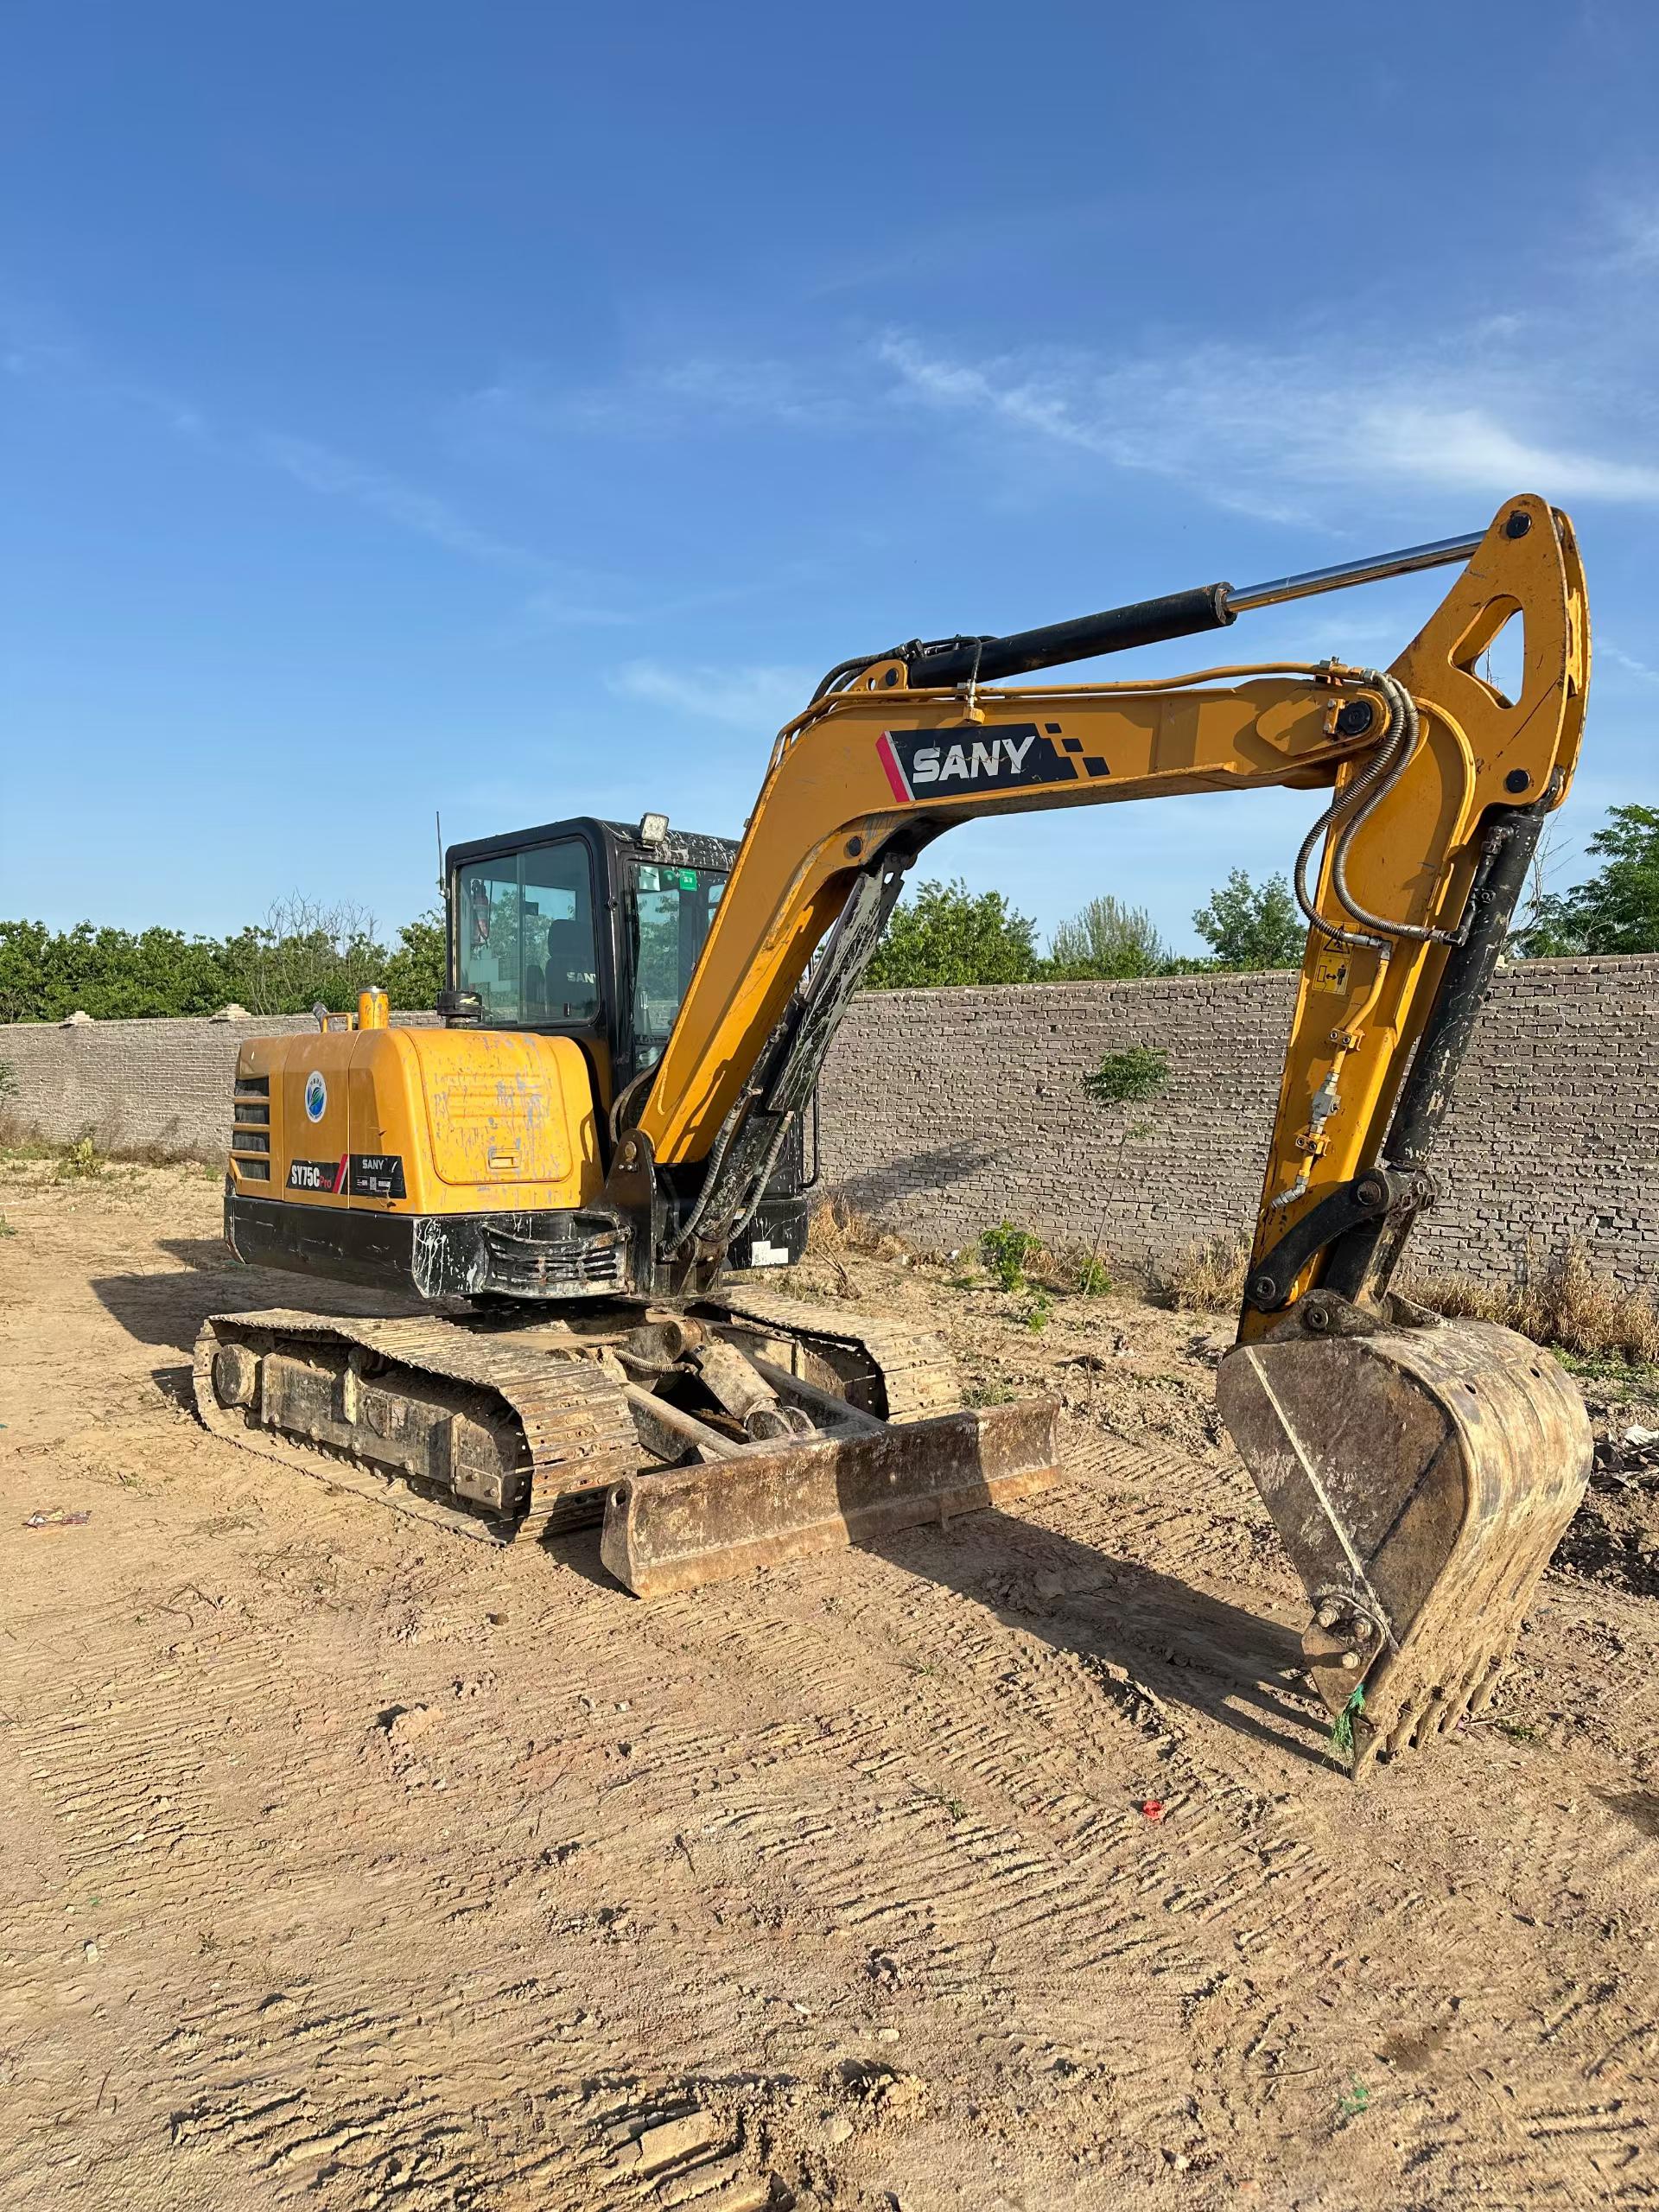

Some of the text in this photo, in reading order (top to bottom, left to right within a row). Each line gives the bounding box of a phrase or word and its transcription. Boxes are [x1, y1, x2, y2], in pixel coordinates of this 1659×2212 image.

[912, 735, 1036, 784] SANY
[566, 971, 596, 984] SAN
[362, 1159, 385, 1170] SANY
